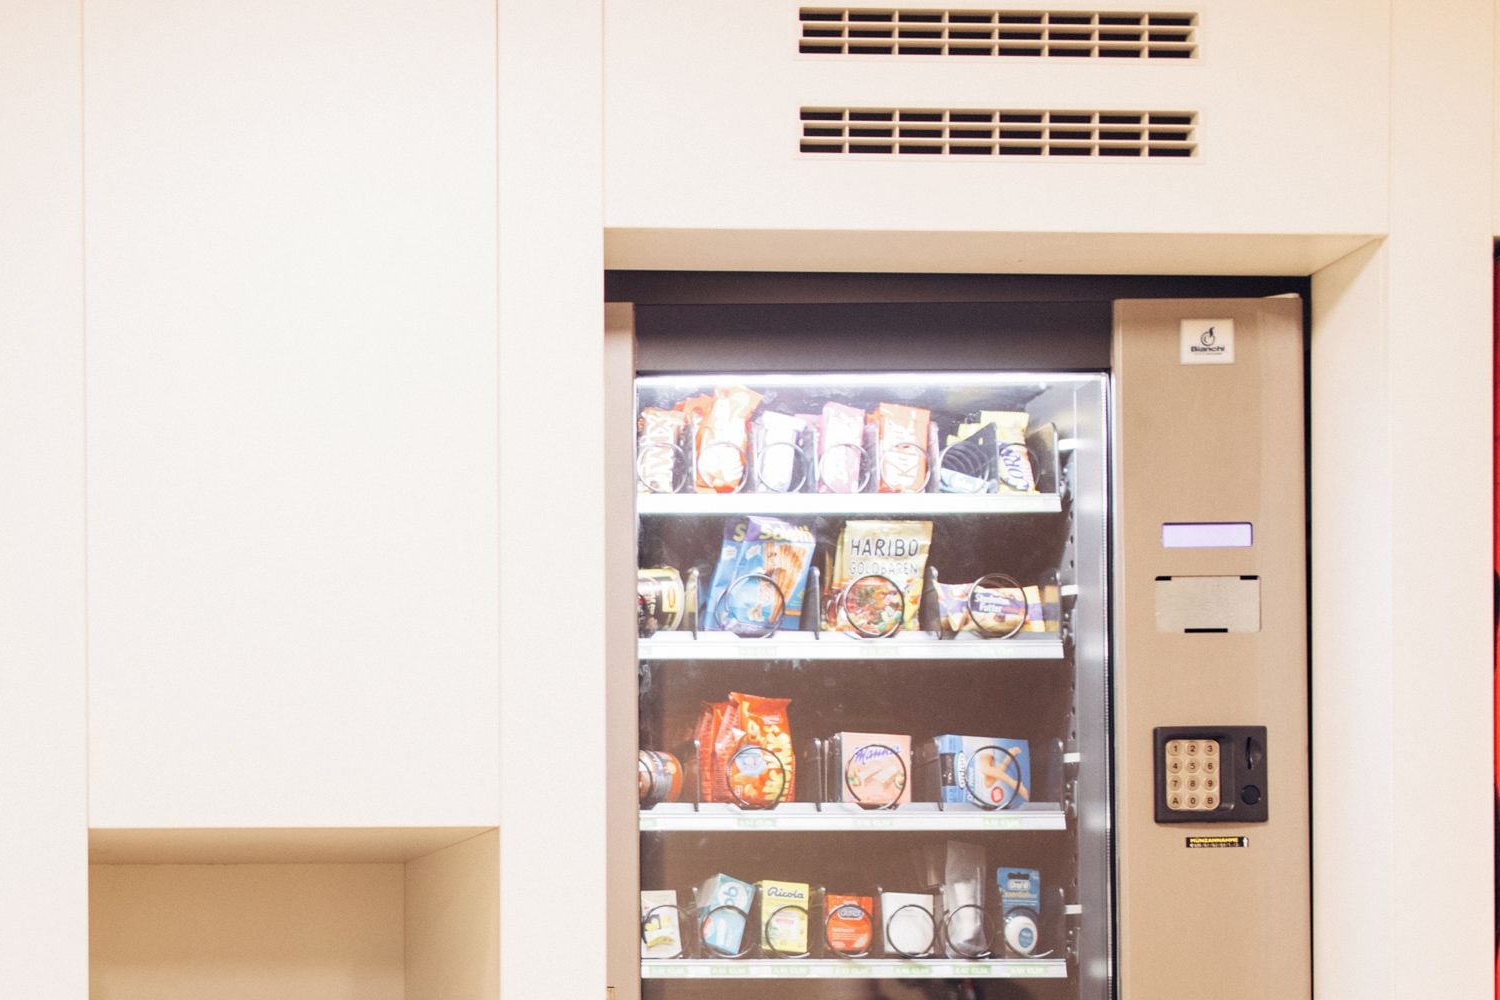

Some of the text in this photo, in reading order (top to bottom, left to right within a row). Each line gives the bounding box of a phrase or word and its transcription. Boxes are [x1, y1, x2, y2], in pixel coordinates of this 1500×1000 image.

[850, 537, 919, 557] HARIBO
[1190, 762, 1196, 770] 5
[767, 886, 804, 899] Ricola
